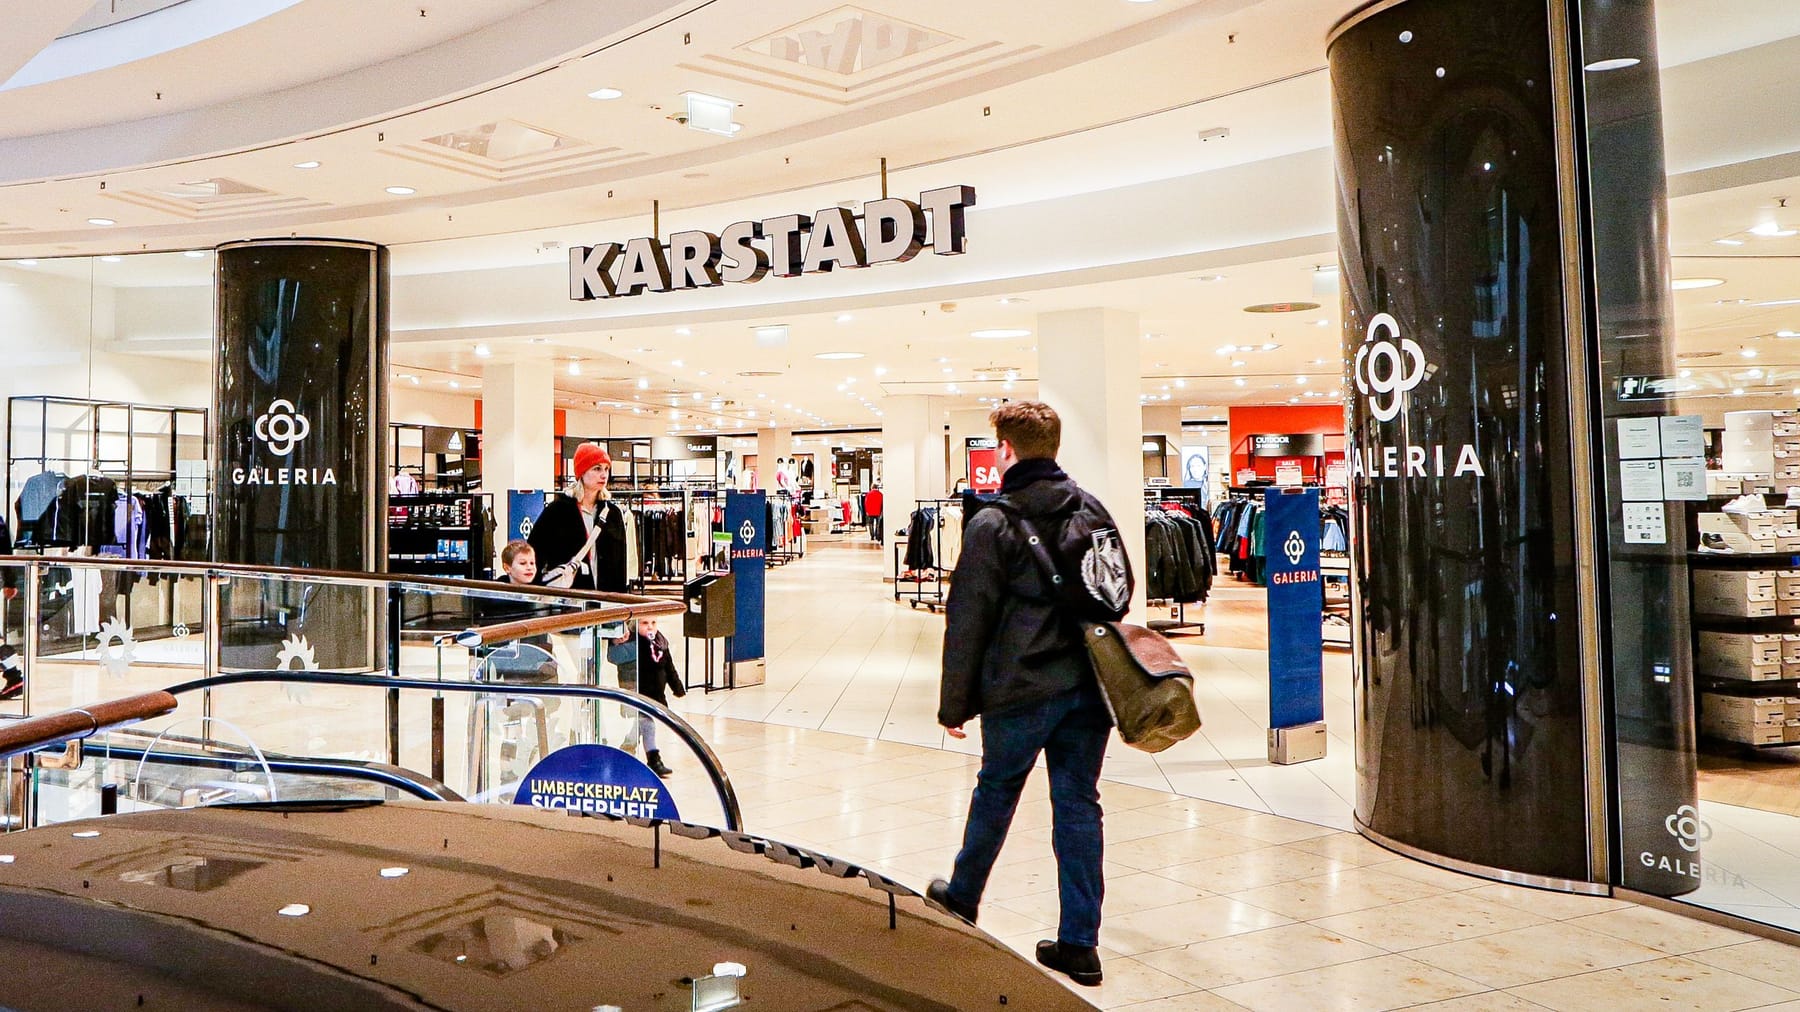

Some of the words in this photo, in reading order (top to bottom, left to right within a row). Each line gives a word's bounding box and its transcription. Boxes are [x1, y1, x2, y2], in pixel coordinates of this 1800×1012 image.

[569, 185, 976, 300] KARSTADT
[231, 467, 337, 486] GALERIA
[975, 466, 1001, 485] SA
[1272, 569, 1317, 584] GALERIA
[530, 779, 659, 803] LIMBECKERPLATZ
[1639, 851, 1747, 891] GALERIA
